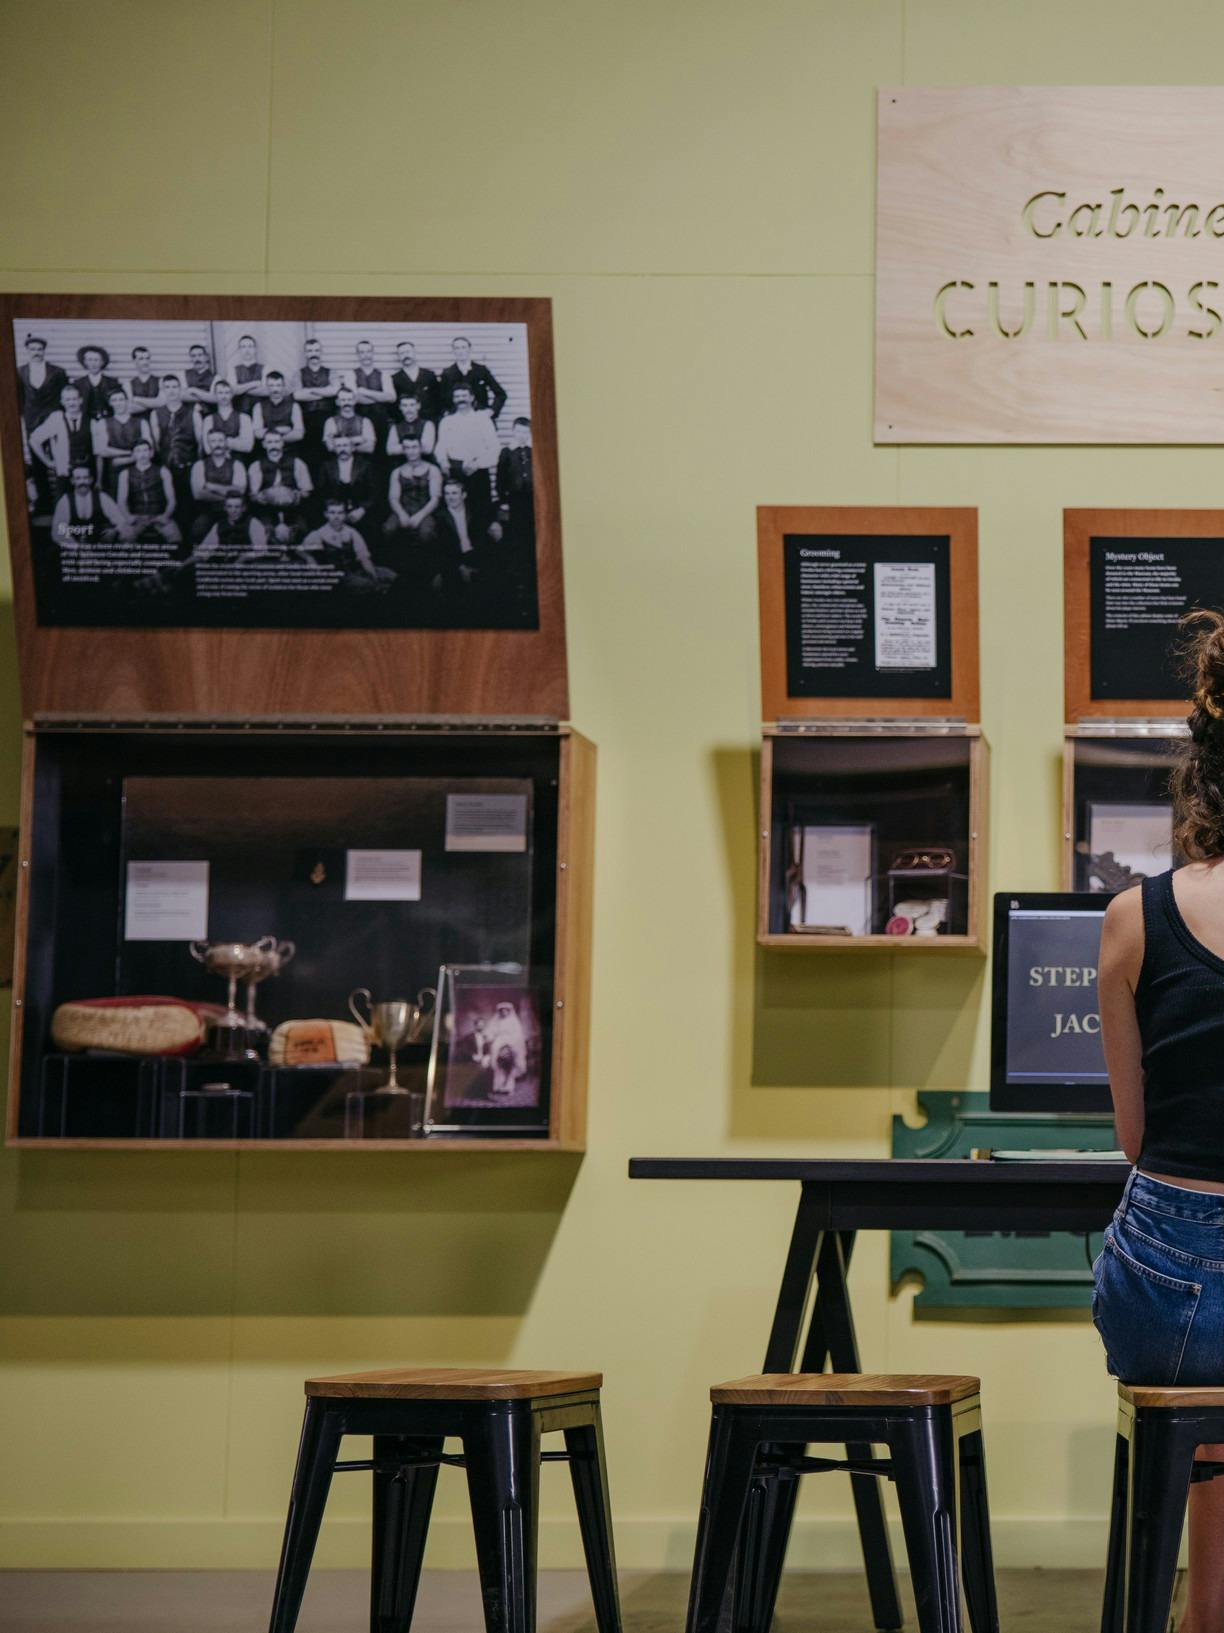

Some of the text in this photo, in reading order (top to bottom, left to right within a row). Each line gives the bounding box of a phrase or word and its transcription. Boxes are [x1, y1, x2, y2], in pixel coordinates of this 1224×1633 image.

[58, 522, 94, 538] Sport
[800, 549, 840, 560] Grooming
[1105, 552, 1164, 562] Mystery Object
